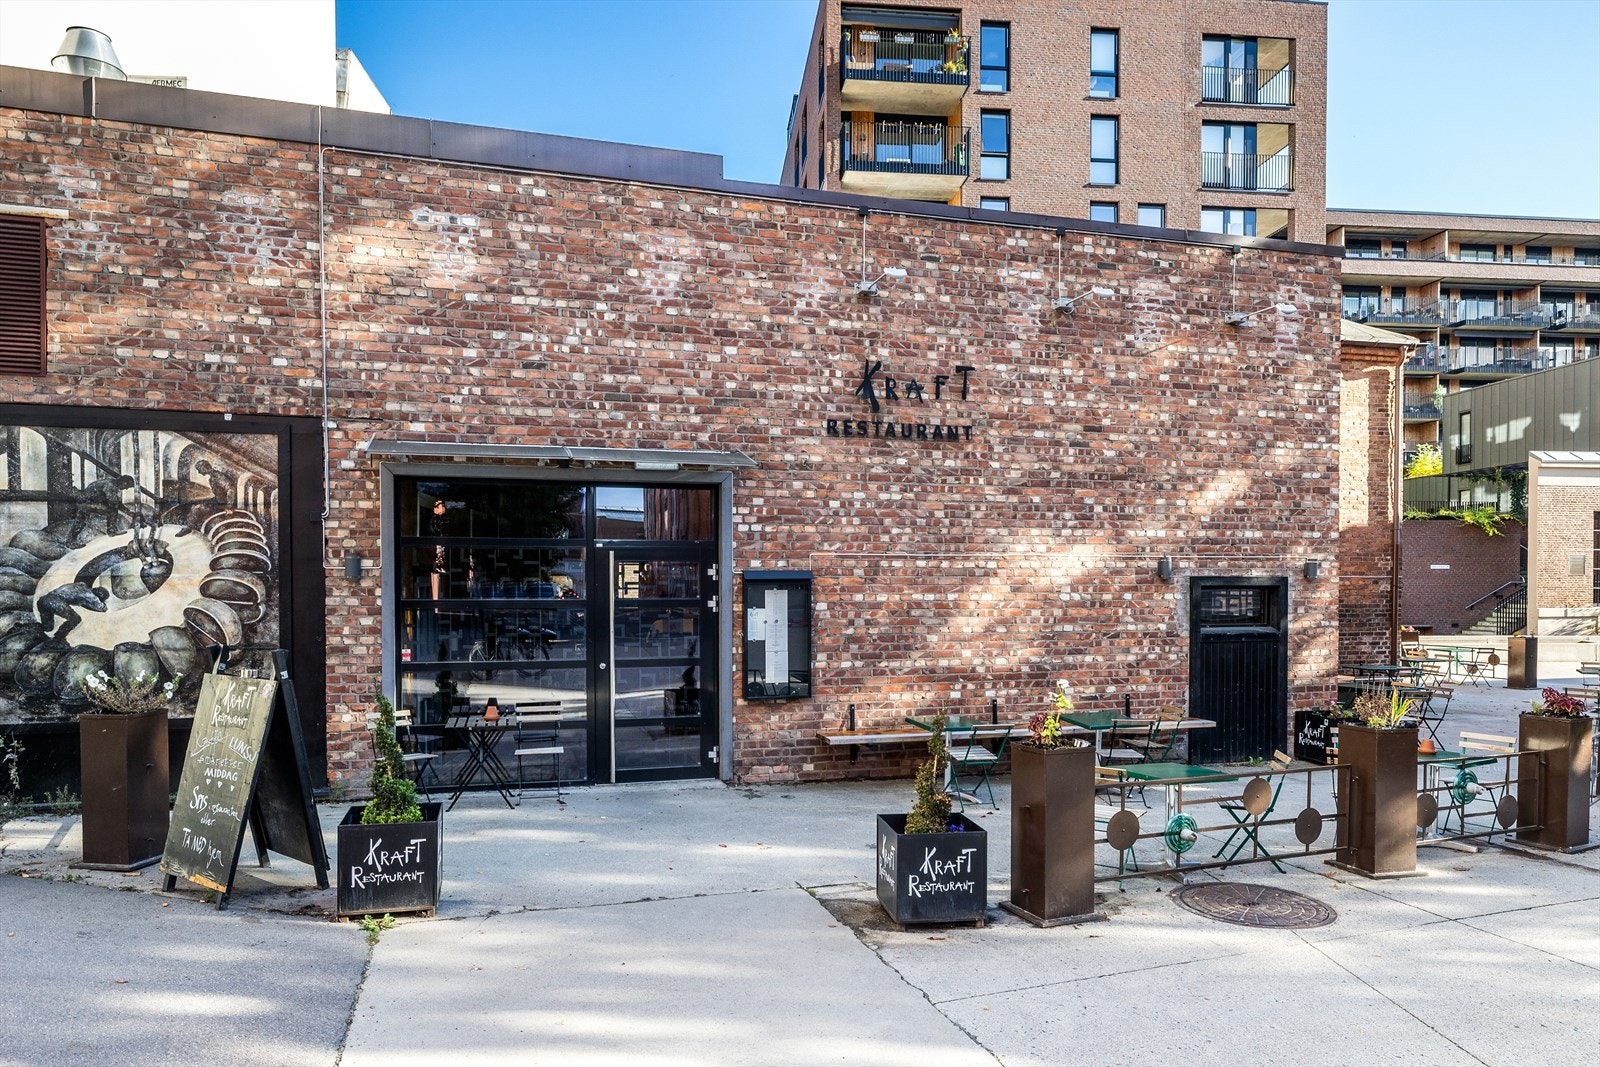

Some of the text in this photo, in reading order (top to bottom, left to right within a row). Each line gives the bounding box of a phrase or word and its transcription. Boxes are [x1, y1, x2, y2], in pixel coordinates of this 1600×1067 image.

[855, 359, 975, 412] KRAFT
[827, 419, 973, 441] RESTAURANT
[222, 681, 257, 713] KRAFT
[1304, 720, 1326, 738] KRAFT
[228, 737, 258, 763] LUNSJ
[204, 768, 238, 782] MIDDAG
[182, 828, 224, 869] TA MED hjem
[363, 838, 427, 872] KRAFT
[351, 865, 425, 889] RESTAURANT
[919, 847, 977, 881] KRAFT
[908, 874, 975, 898] RESTAURANT
